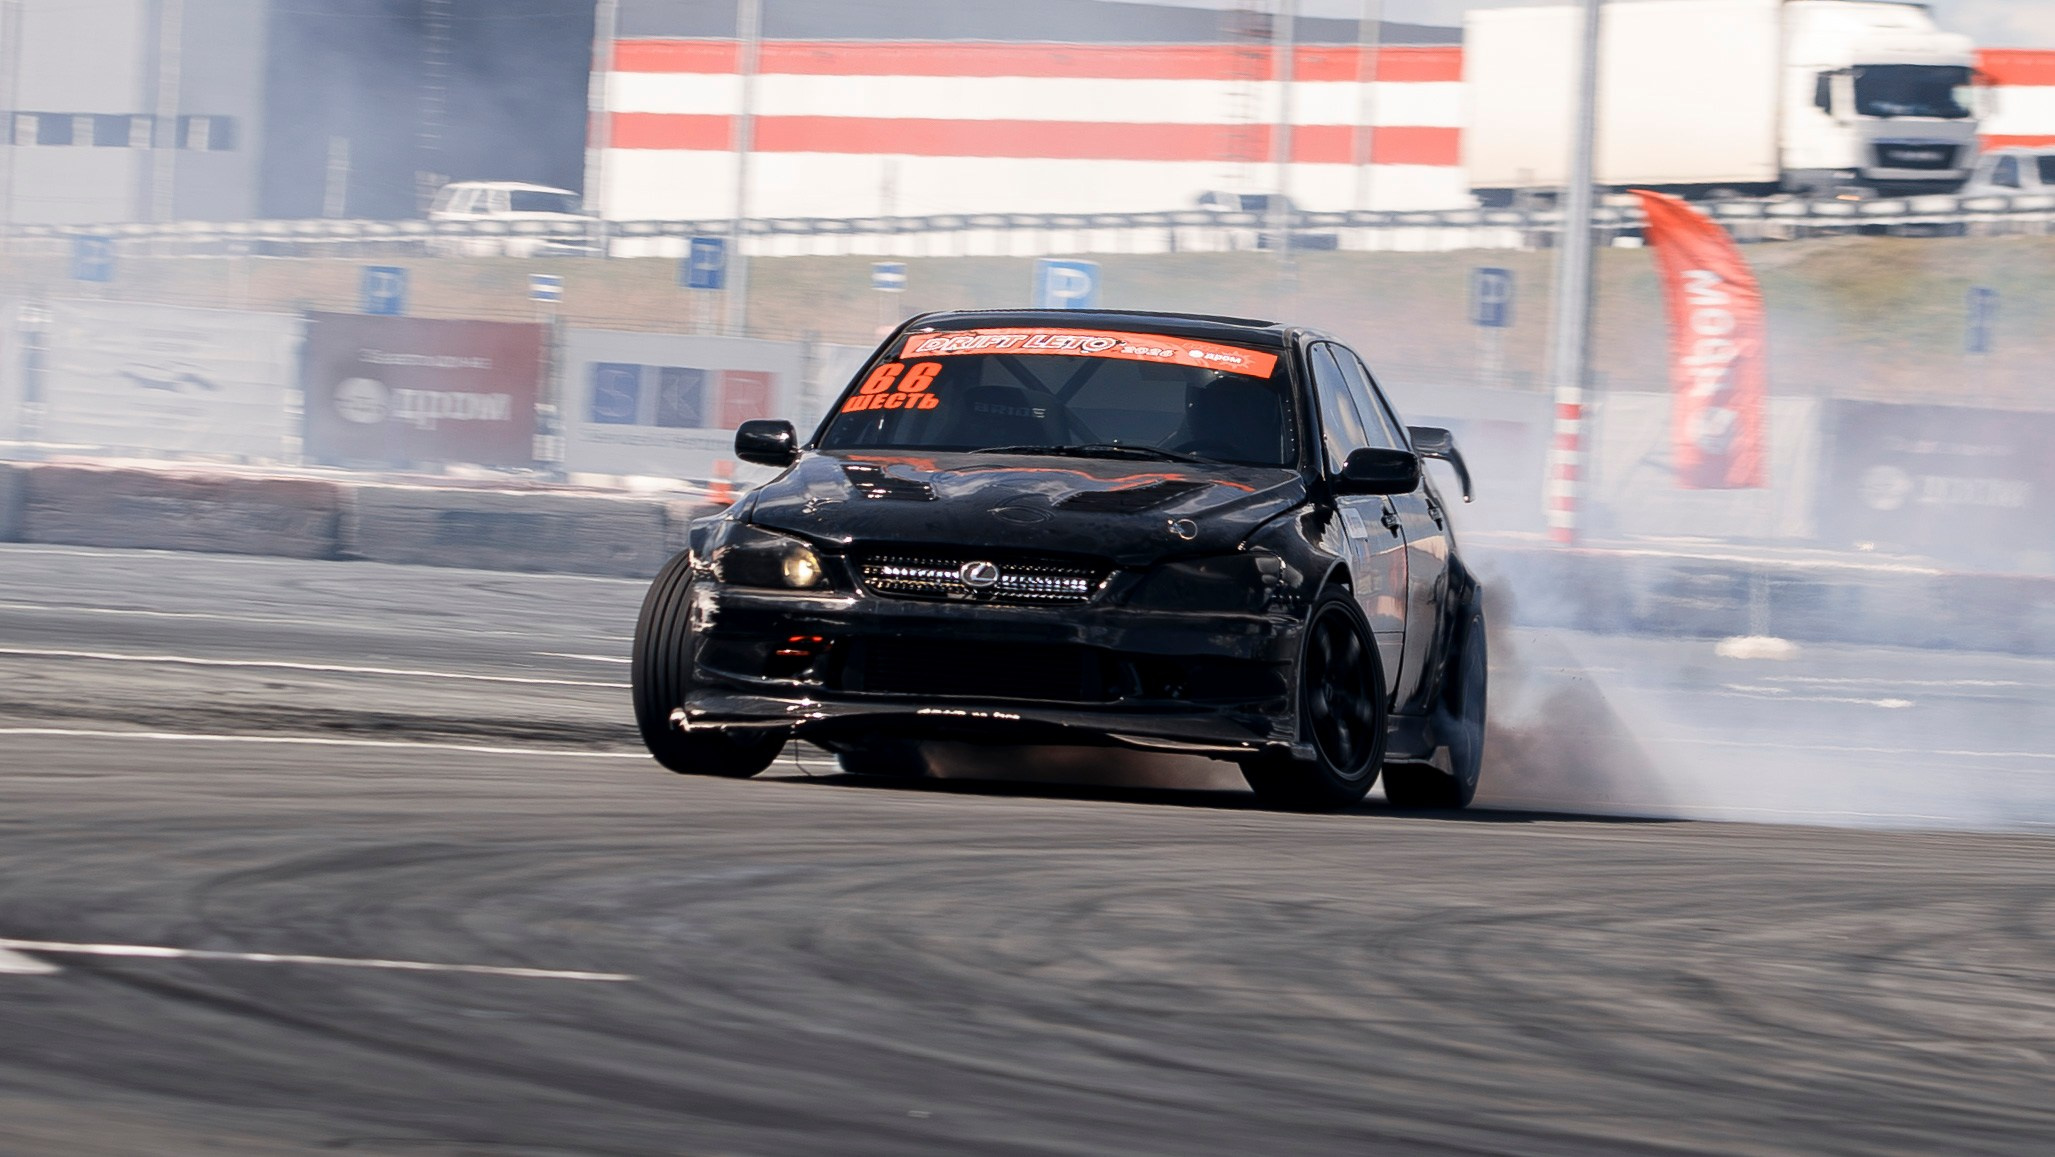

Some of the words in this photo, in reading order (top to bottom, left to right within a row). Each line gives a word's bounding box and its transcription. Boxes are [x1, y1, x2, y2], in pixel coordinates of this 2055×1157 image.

[1046, 267, 1090, 308] P
[915, 334, 1029, 353] DRIFT
[1021, 334, 1117, 353] LETO
[1203, 352, 1242, 364] дром
[860, 362, 942, 395] 66
[841, 393, 940, 413] ШЕСТЬ
